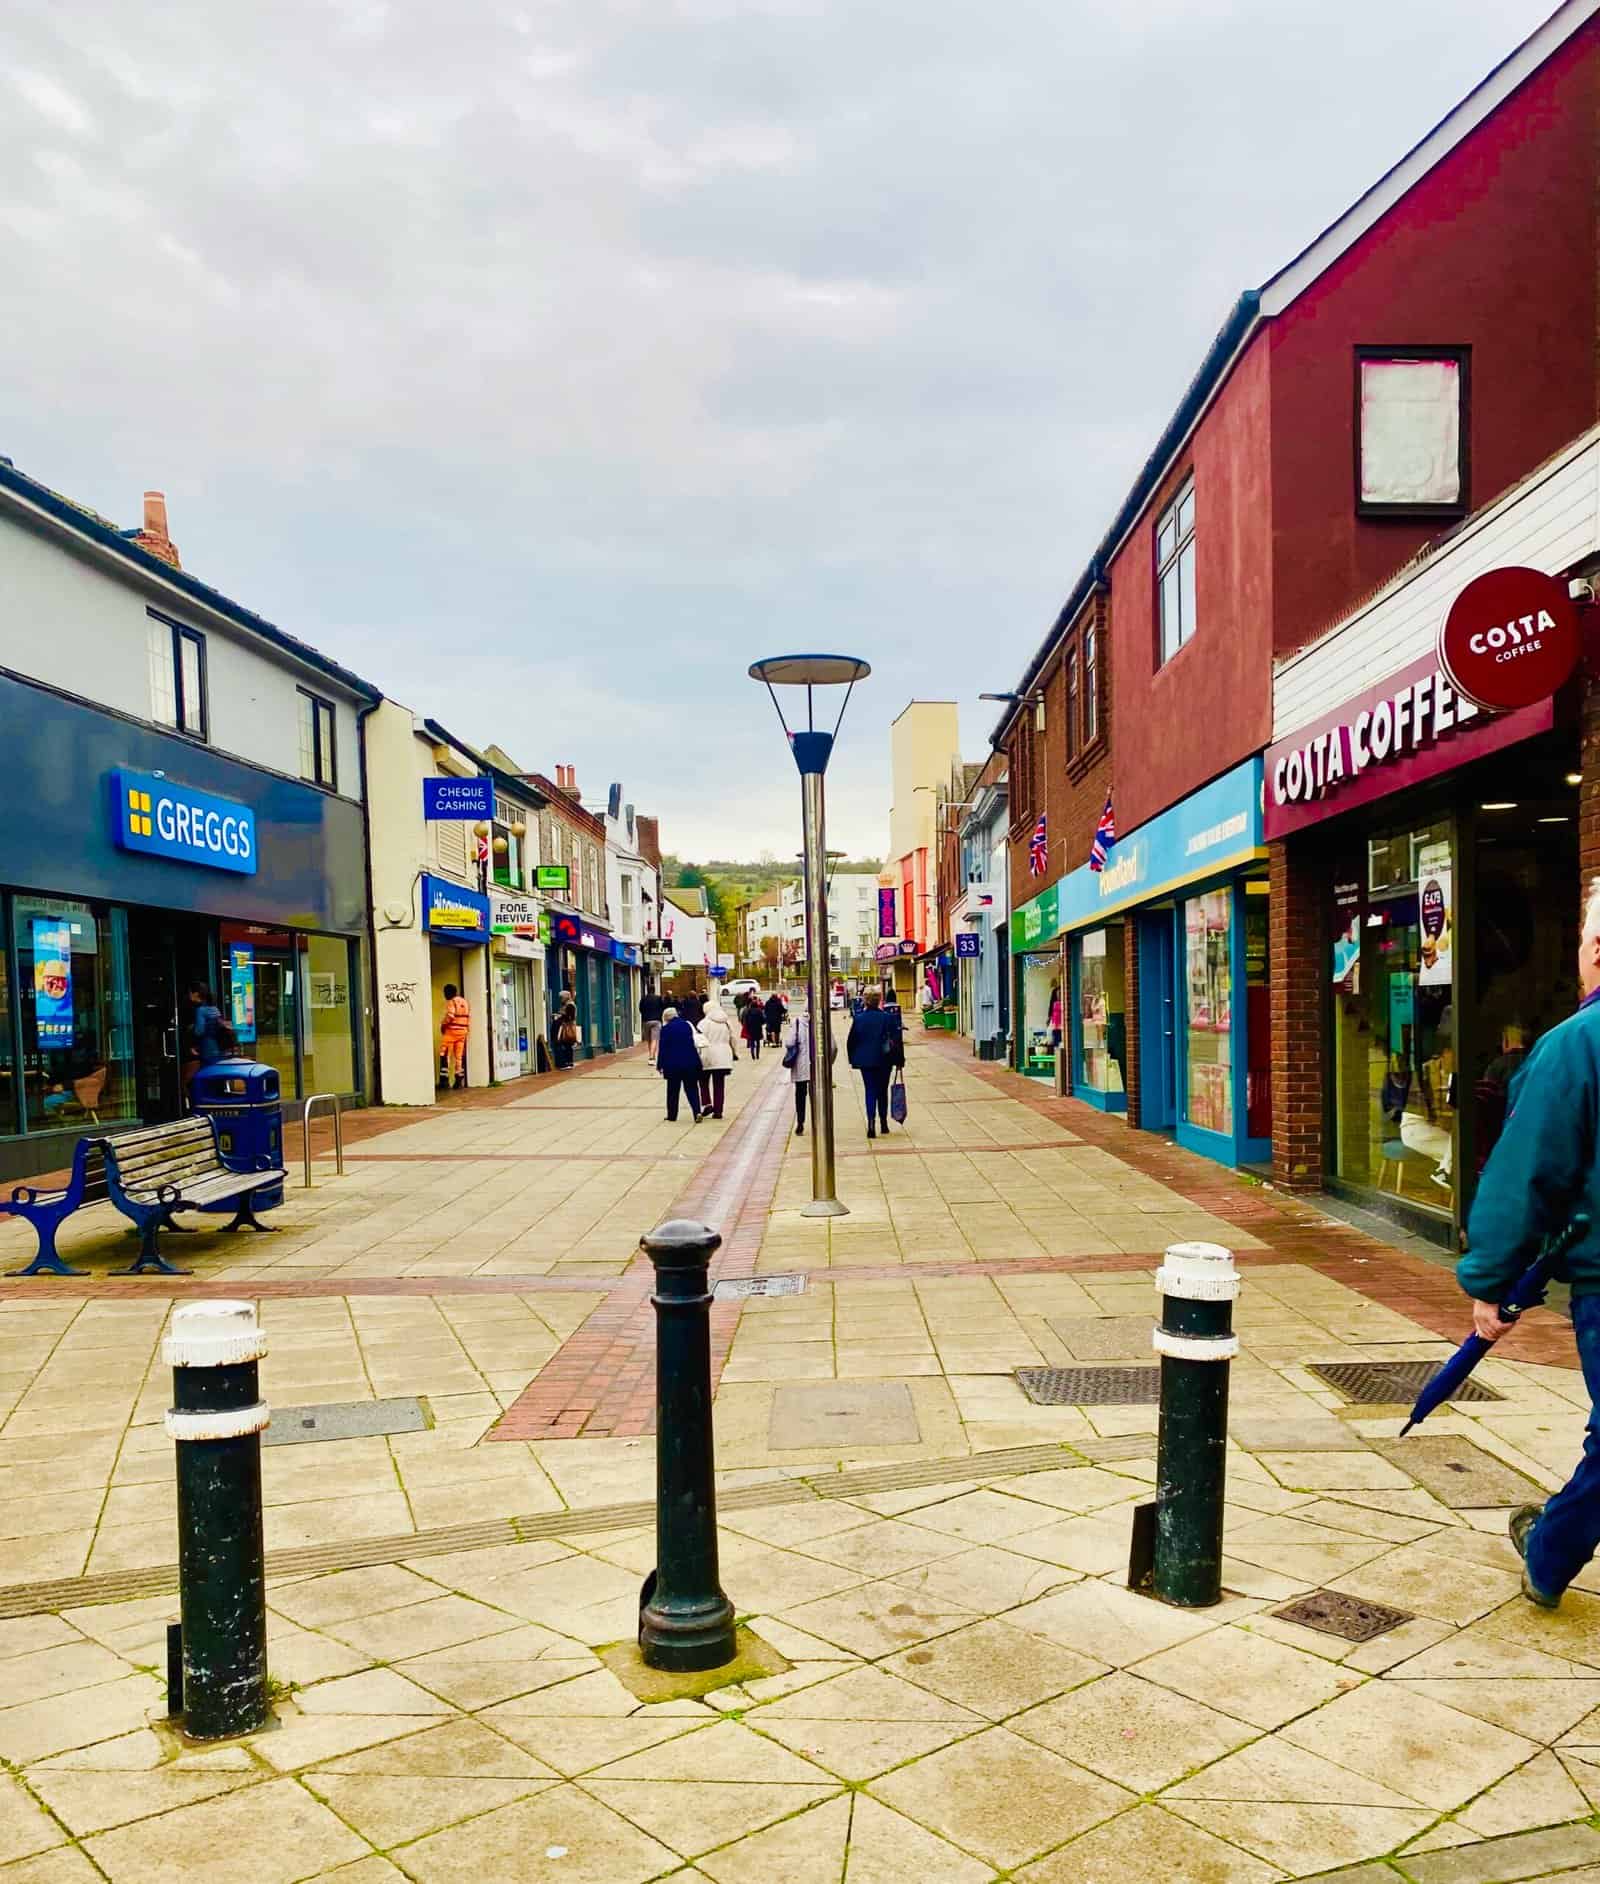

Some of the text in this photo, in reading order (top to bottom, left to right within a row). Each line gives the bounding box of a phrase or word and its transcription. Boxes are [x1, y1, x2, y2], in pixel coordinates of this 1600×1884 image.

[1469, 609, 1556, 655] COSTA
[1495, 639, 1542, 663] COFFEE
[1274, 727, 1344, 806] COSTA
[438, 787, 484, 797] CHEQUE
[436, 800, 487, 811] CASHING
[156, 798, 251, 858] GREGGS
[495, 913, 533, 924] REVIVE
[960, 940, 976, 952] 33
